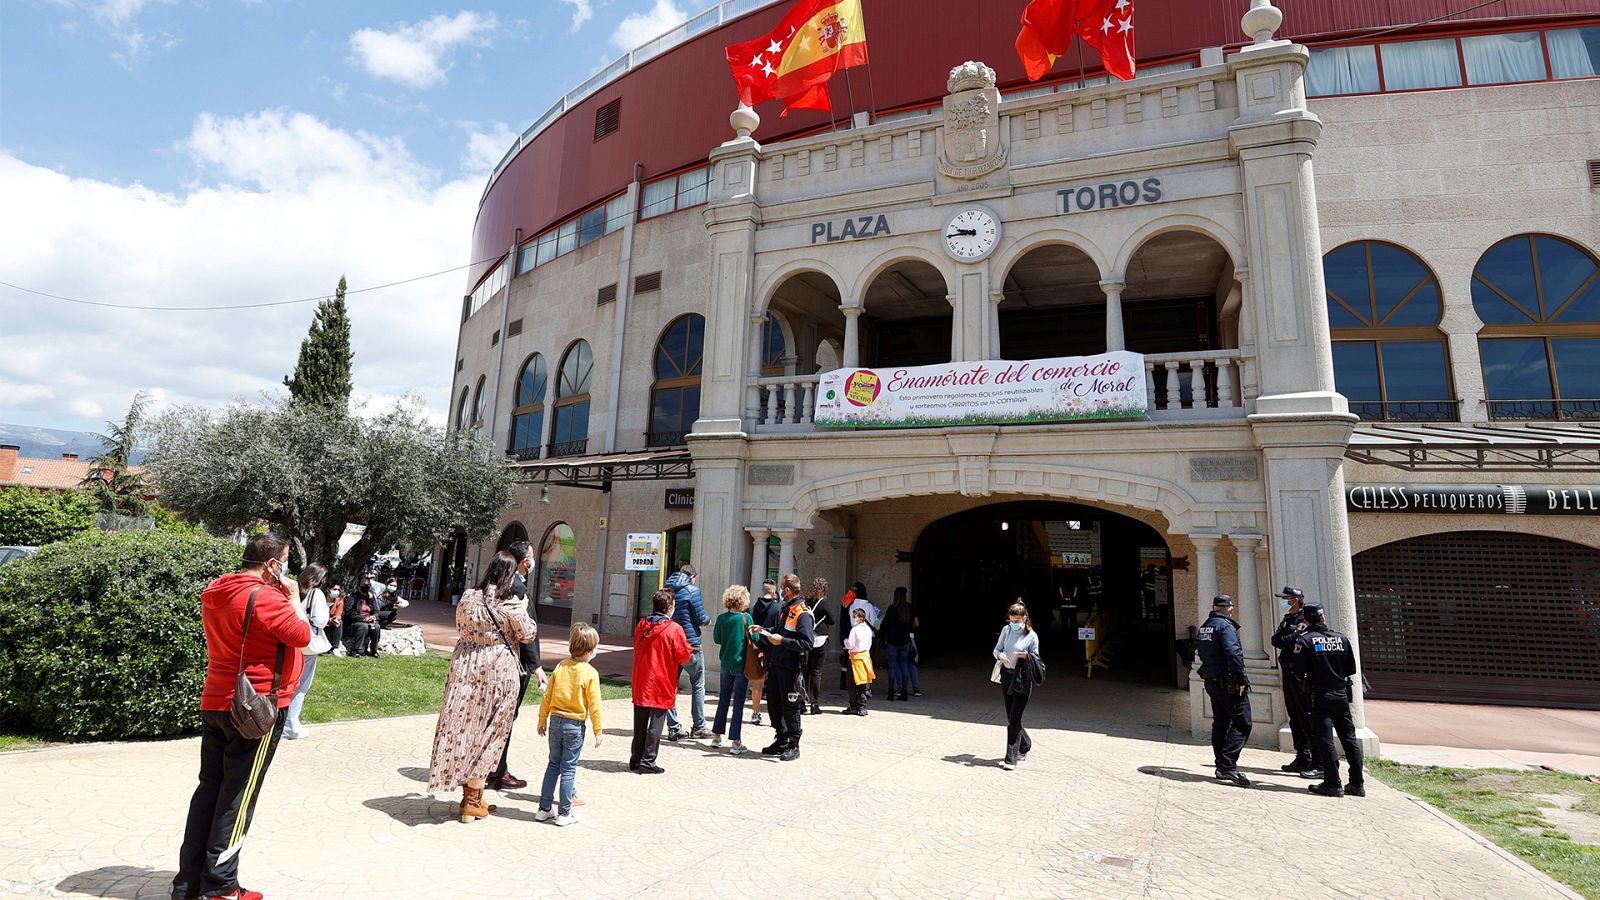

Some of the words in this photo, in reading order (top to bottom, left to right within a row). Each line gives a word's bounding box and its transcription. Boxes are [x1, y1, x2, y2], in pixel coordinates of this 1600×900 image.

[970, 182, 989, 191] 2005
[1057, 177, 1162, 213] TOROS
[811, 214, 891, 244] PLAZA
[887, 365, 991, 392] Enamórate
[994, 363, 1029, 385] del
[1031, 359, 1121, 382] comercio
[944, 392, 977, 400] regalamos
[978, 390, 1003, 398] BOLSAS
[1004, 387, 1044, 395] reutilizables
[1059, 377, 1074, 390] de
[1073, 376, 1136, 397] Moral
[947, 400, 979, 408] CARRITOS
[996, 397, 1027, 405] COMPRA
[1349, 486, 1409, 510] CELESS
[1413, 492, 1503, 510] PELUQUEROS
[1547, 488, 1600, 511] BELL
[806, 539, 815, 554] 8
[1065, 555, 1071, 564] 3
[1073, 555, 1080, 564] A
[1312, 636, 1343, 645] POLICIA
[1323, 643, 1345, 652] LOCAL
